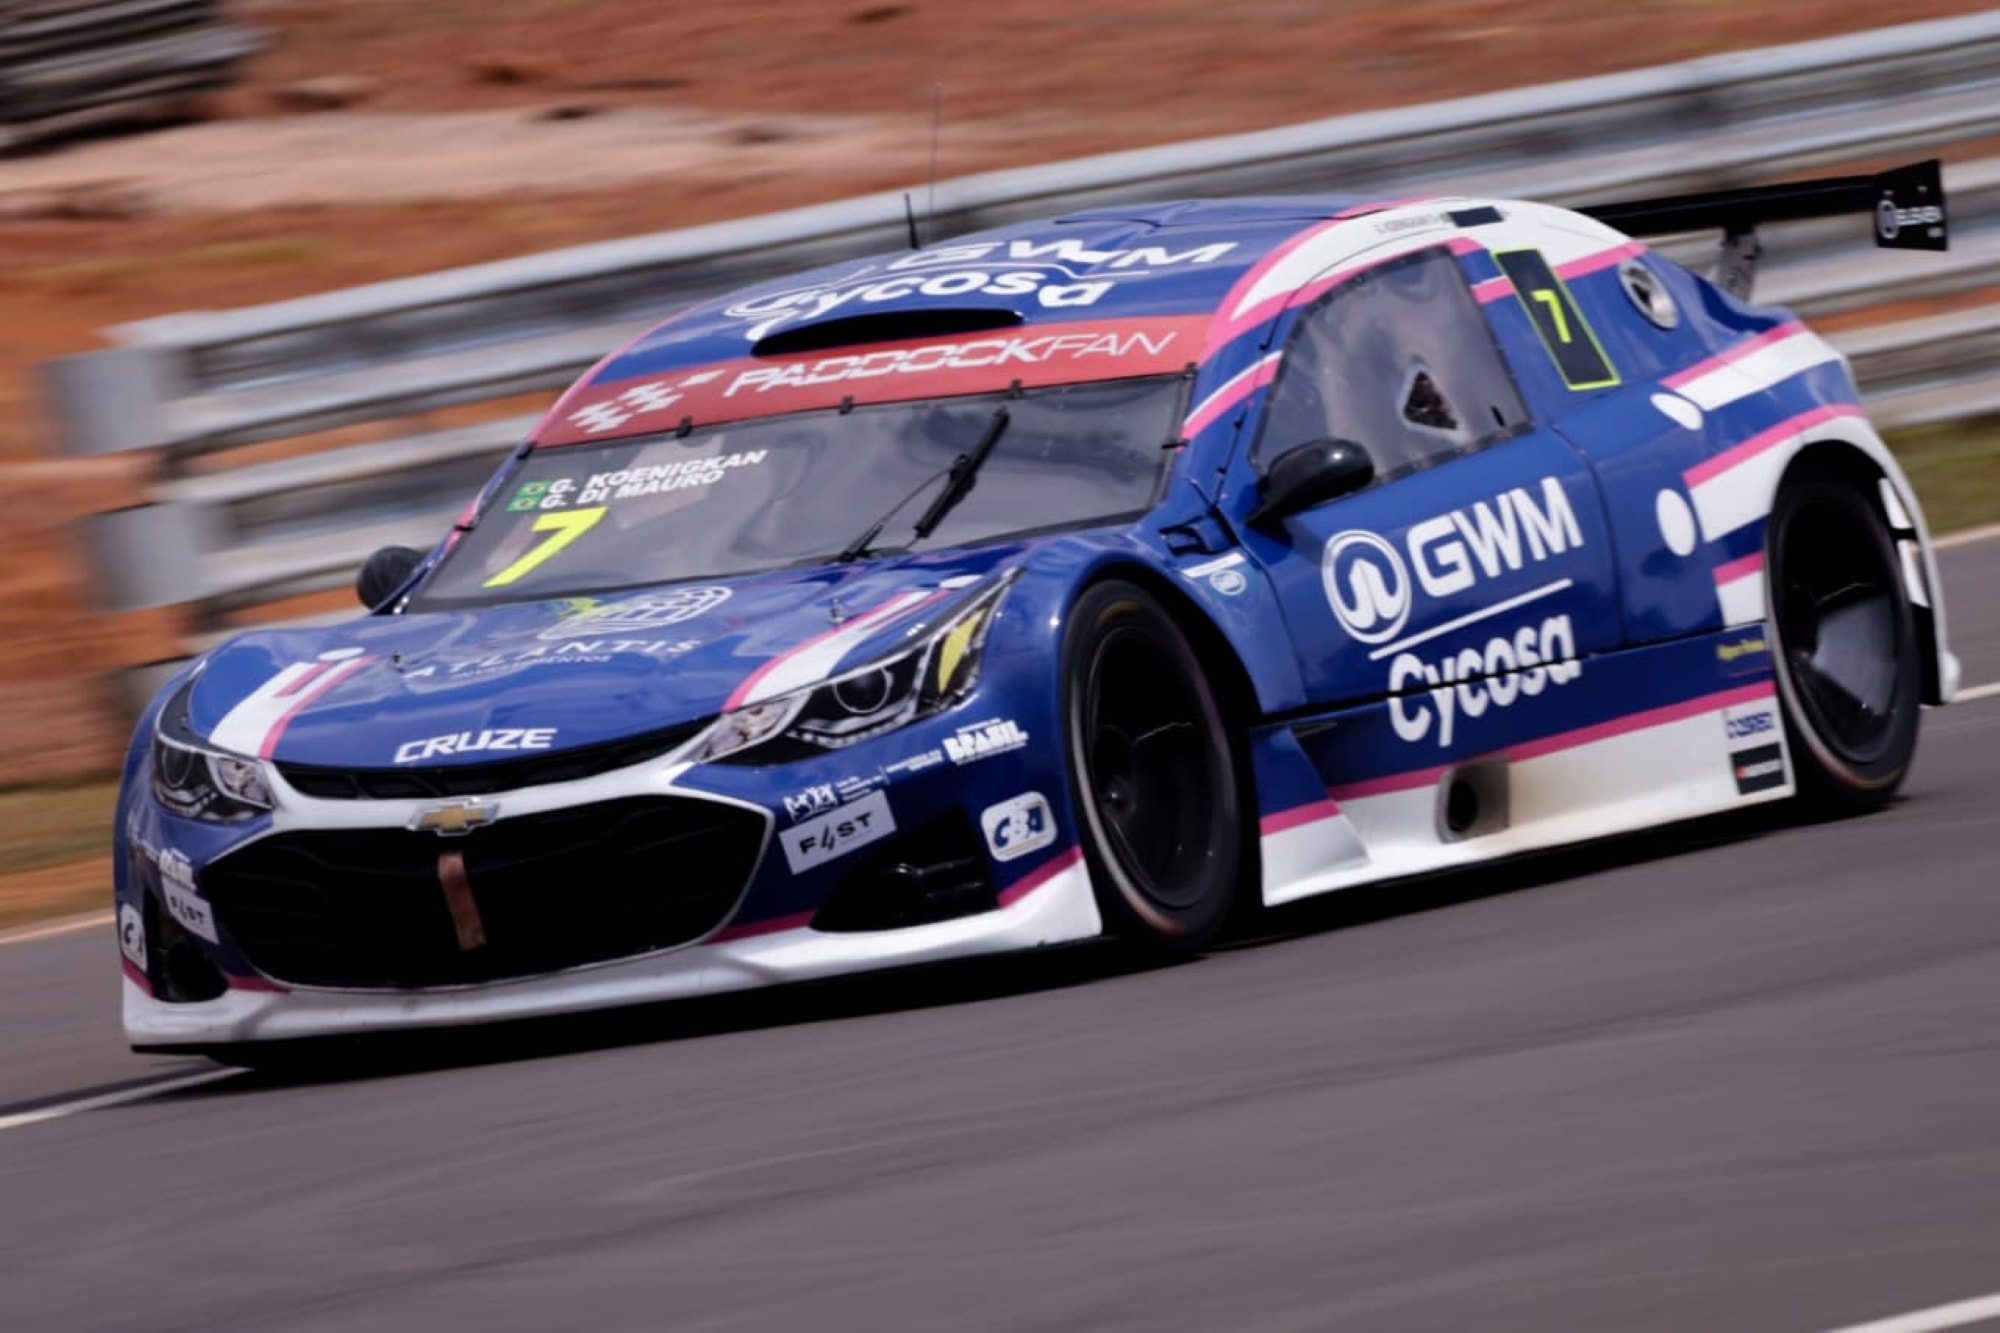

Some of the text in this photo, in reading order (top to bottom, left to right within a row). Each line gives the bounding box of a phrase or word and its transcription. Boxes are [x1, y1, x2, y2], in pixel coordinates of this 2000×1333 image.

[887, 239, 1239, 271] GWM
[1530, 288, 1572, 344] 7
[538, 469, 726, 510] G. DI MAURO
[548, 449, 769, 494] G. KOENIGKAN
[480, 505, 609, 589] 7
[1405, 475, 1585, 598] GWM
[1387, 613, 1583, 748] Cycosa
[393, 727, 558, 764] CRUZE
